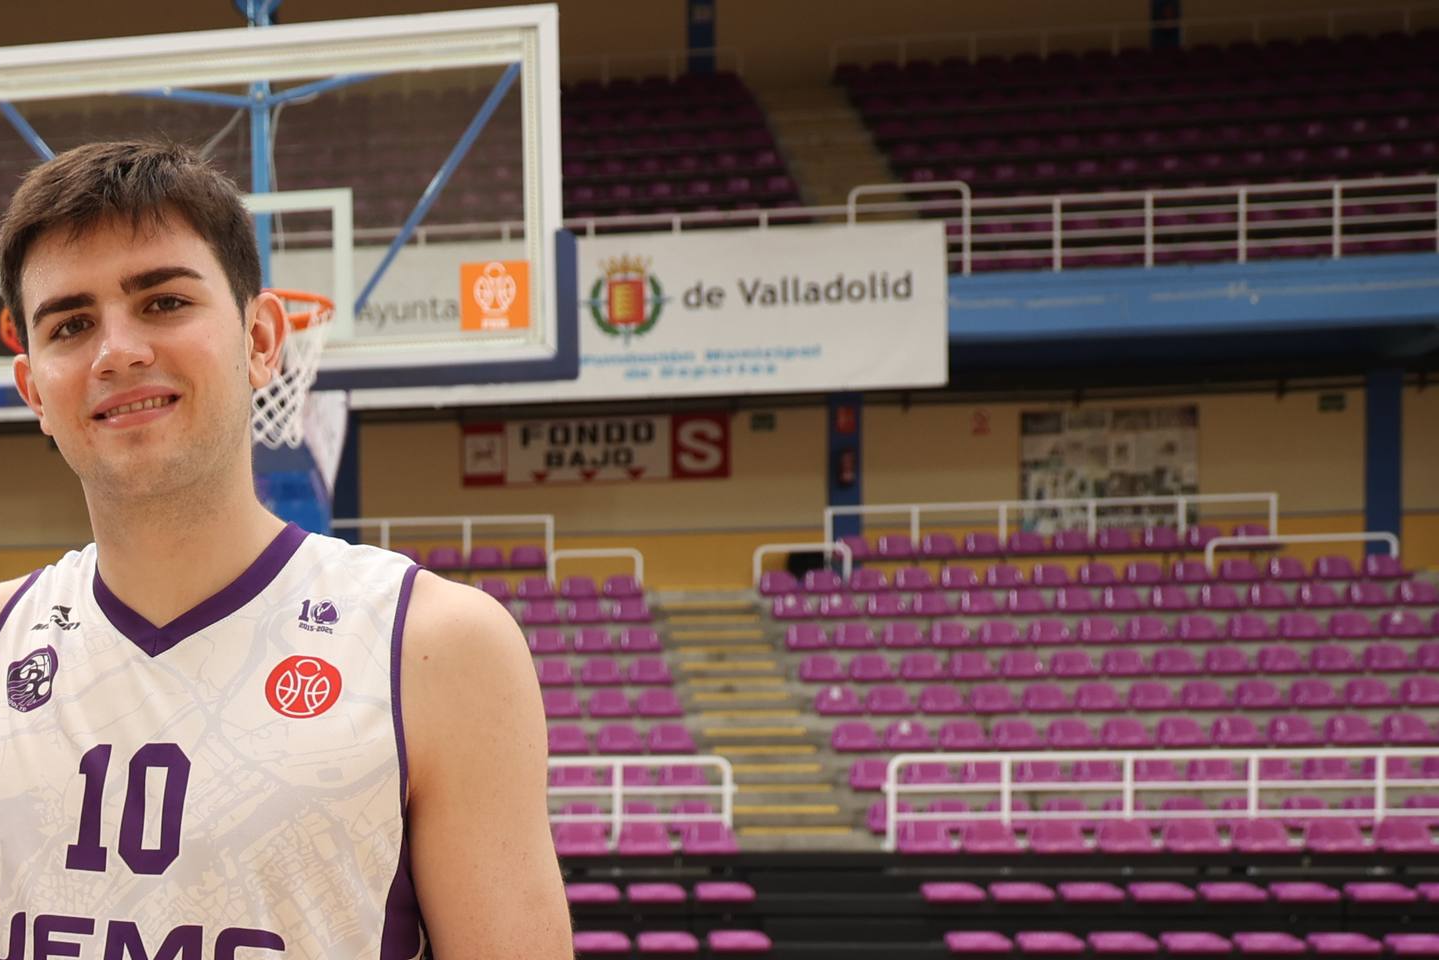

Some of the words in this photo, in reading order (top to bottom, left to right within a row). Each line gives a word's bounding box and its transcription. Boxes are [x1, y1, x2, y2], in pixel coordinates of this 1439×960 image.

[683, 281, 726, 309] de
[739, 272, 913, 306] Valladolid
[359, 298, 460, 328] Ayunta
[519, 419, 656, 447] FONDO
[677, 418, 724, 475] S
[545, 447, 634, 469] BAJO
[65, 743, 191, 875] 10
